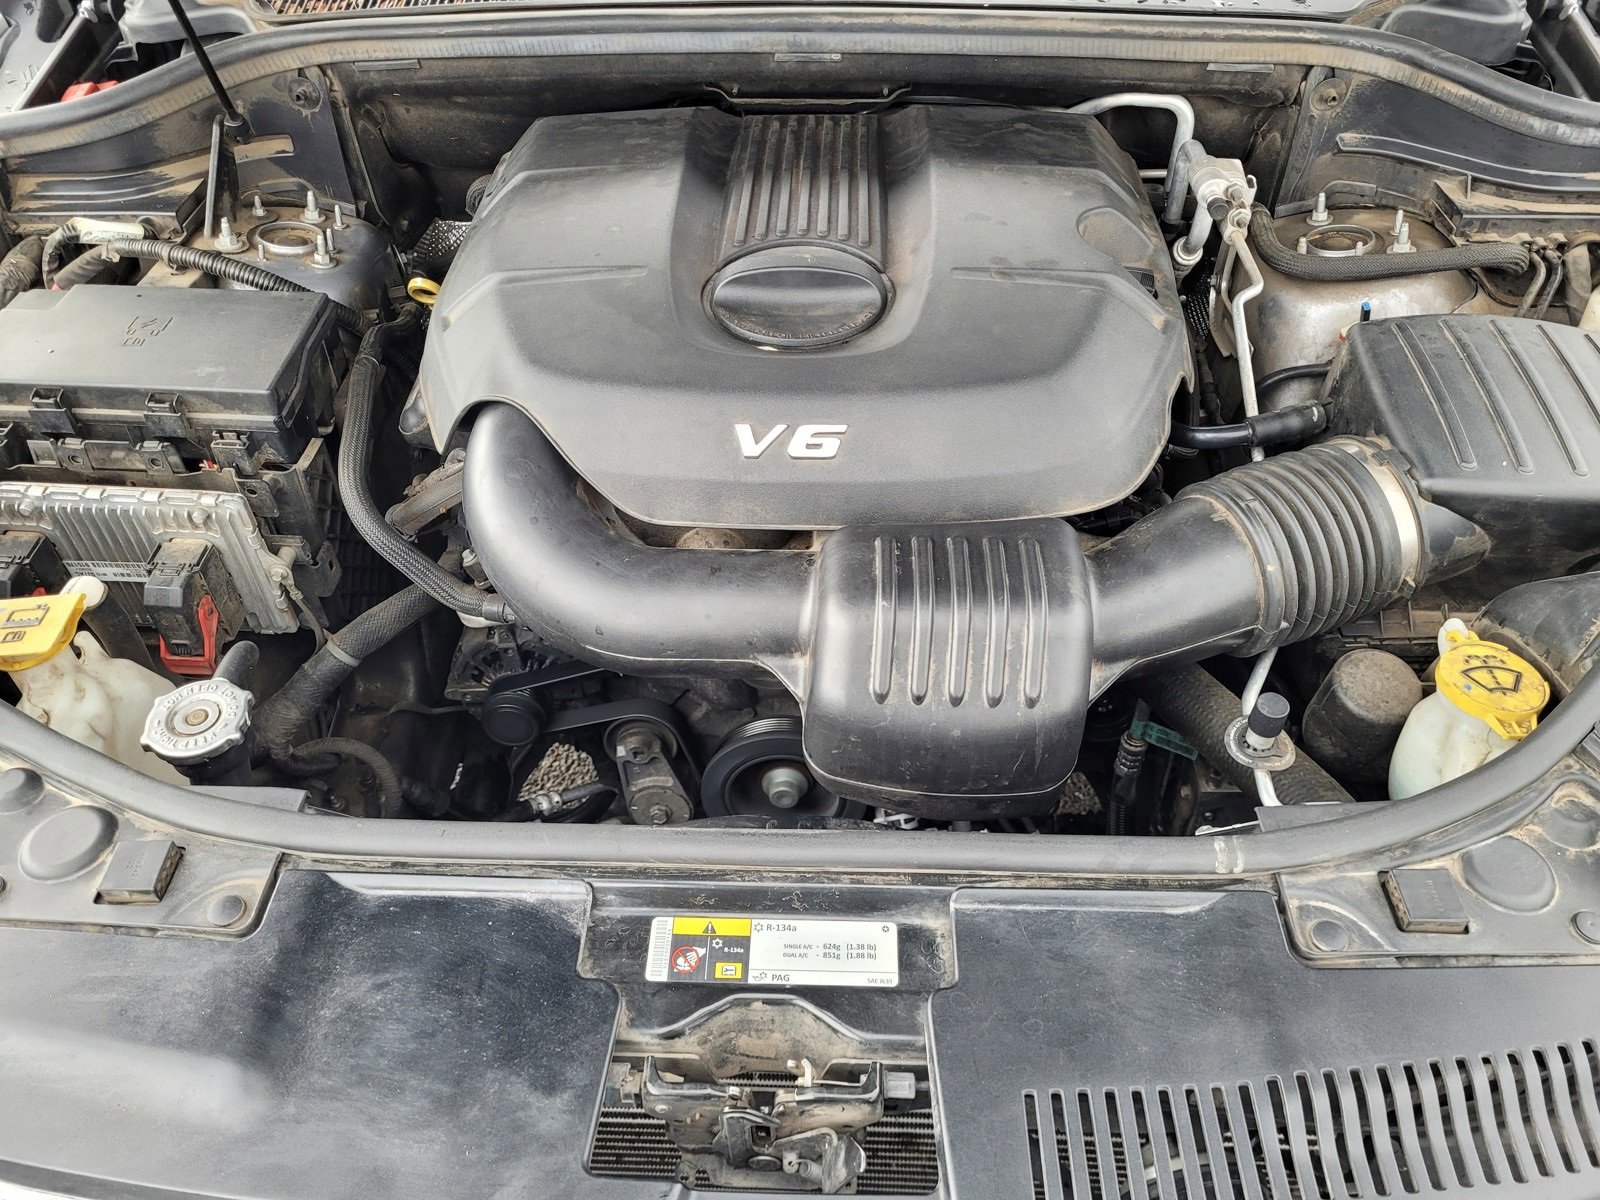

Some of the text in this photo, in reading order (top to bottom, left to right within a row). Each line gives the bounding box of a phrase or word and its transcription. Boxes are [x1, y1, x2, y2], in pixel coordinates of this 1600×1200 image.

[735, 424, 848, 460] V6
[823, 943, 840, 951] 624g
[847, 943, 865, 951] (1.38
[866, 943, 876, 951] lb)
[823, 952, 840, 960] 851g
[847, 952, 865, 960] (1.88
[866, 952, 876, 960] lb)
[772, 974, 790, 982] PAG
